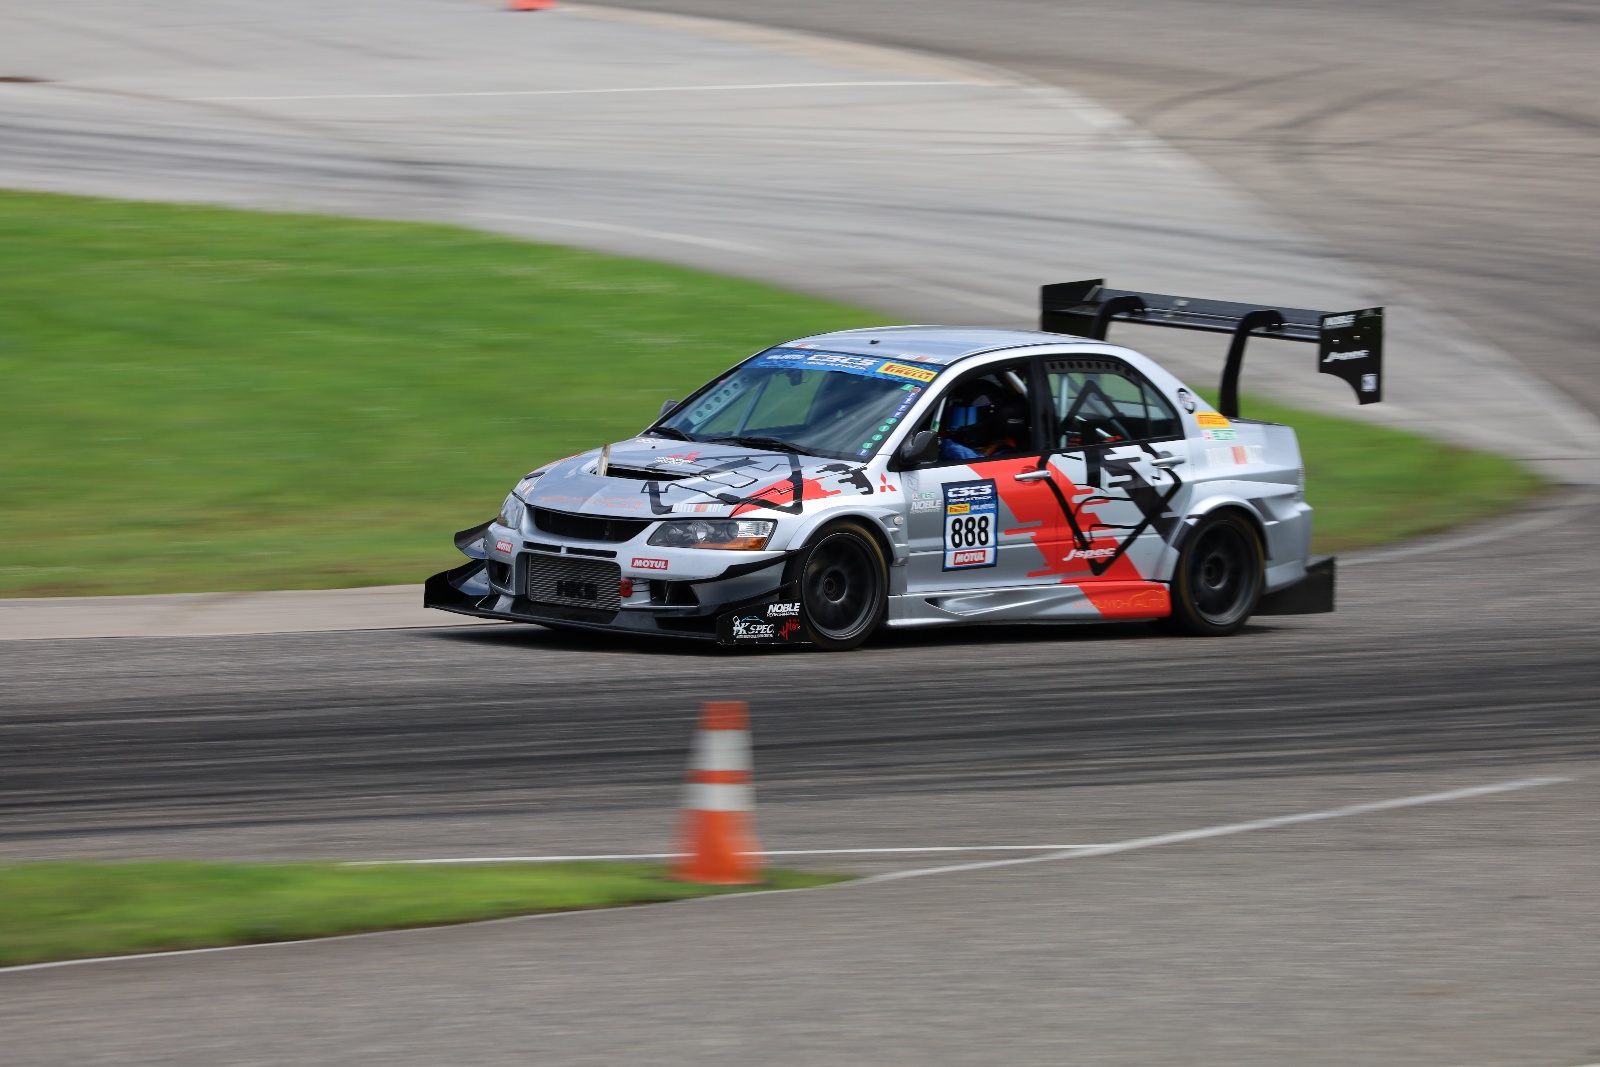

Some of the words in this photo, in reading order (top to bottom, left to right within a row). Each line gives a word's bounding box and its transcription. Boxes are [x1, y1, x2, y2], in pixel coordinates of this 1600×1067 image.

[884, 364, 933, 380] PIRELLI
[911, 500, 942, 511] NOBLE
[951, 515, 989, 548] 888
[955, 551, 985, 563] MOTUL
[1062, 548, 1117, 561] Jspec
[632, 559, 667, 569] MOTUL
[767, 602, 801, 614] NOBLE
